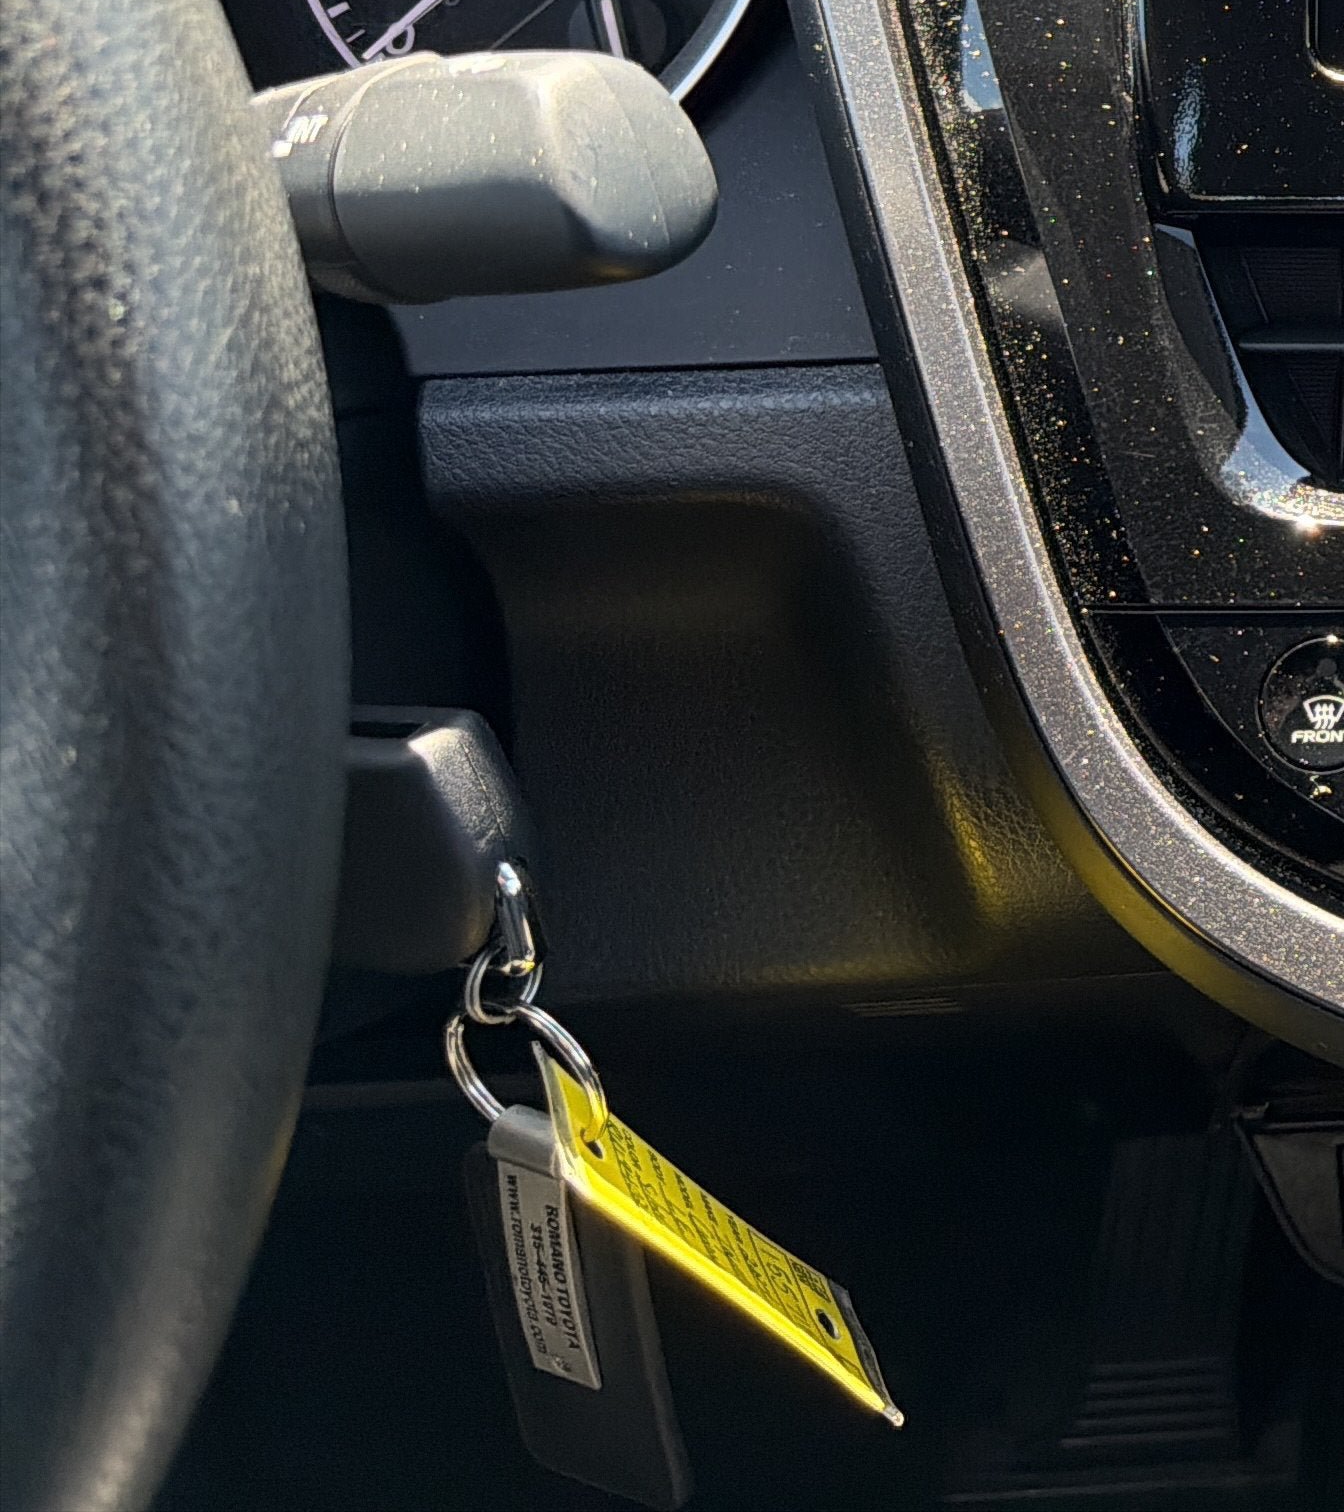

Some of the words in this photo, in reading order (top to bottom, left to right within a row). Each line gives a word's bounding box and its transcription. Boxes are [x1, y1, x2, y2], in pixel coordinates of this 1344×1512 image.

[507, 1174, 547, 1355] www.romanotoyota.com
[546, 1205, 567, 1285] ROMANO
[559, 1287, 580, 1351] TOYOTA
